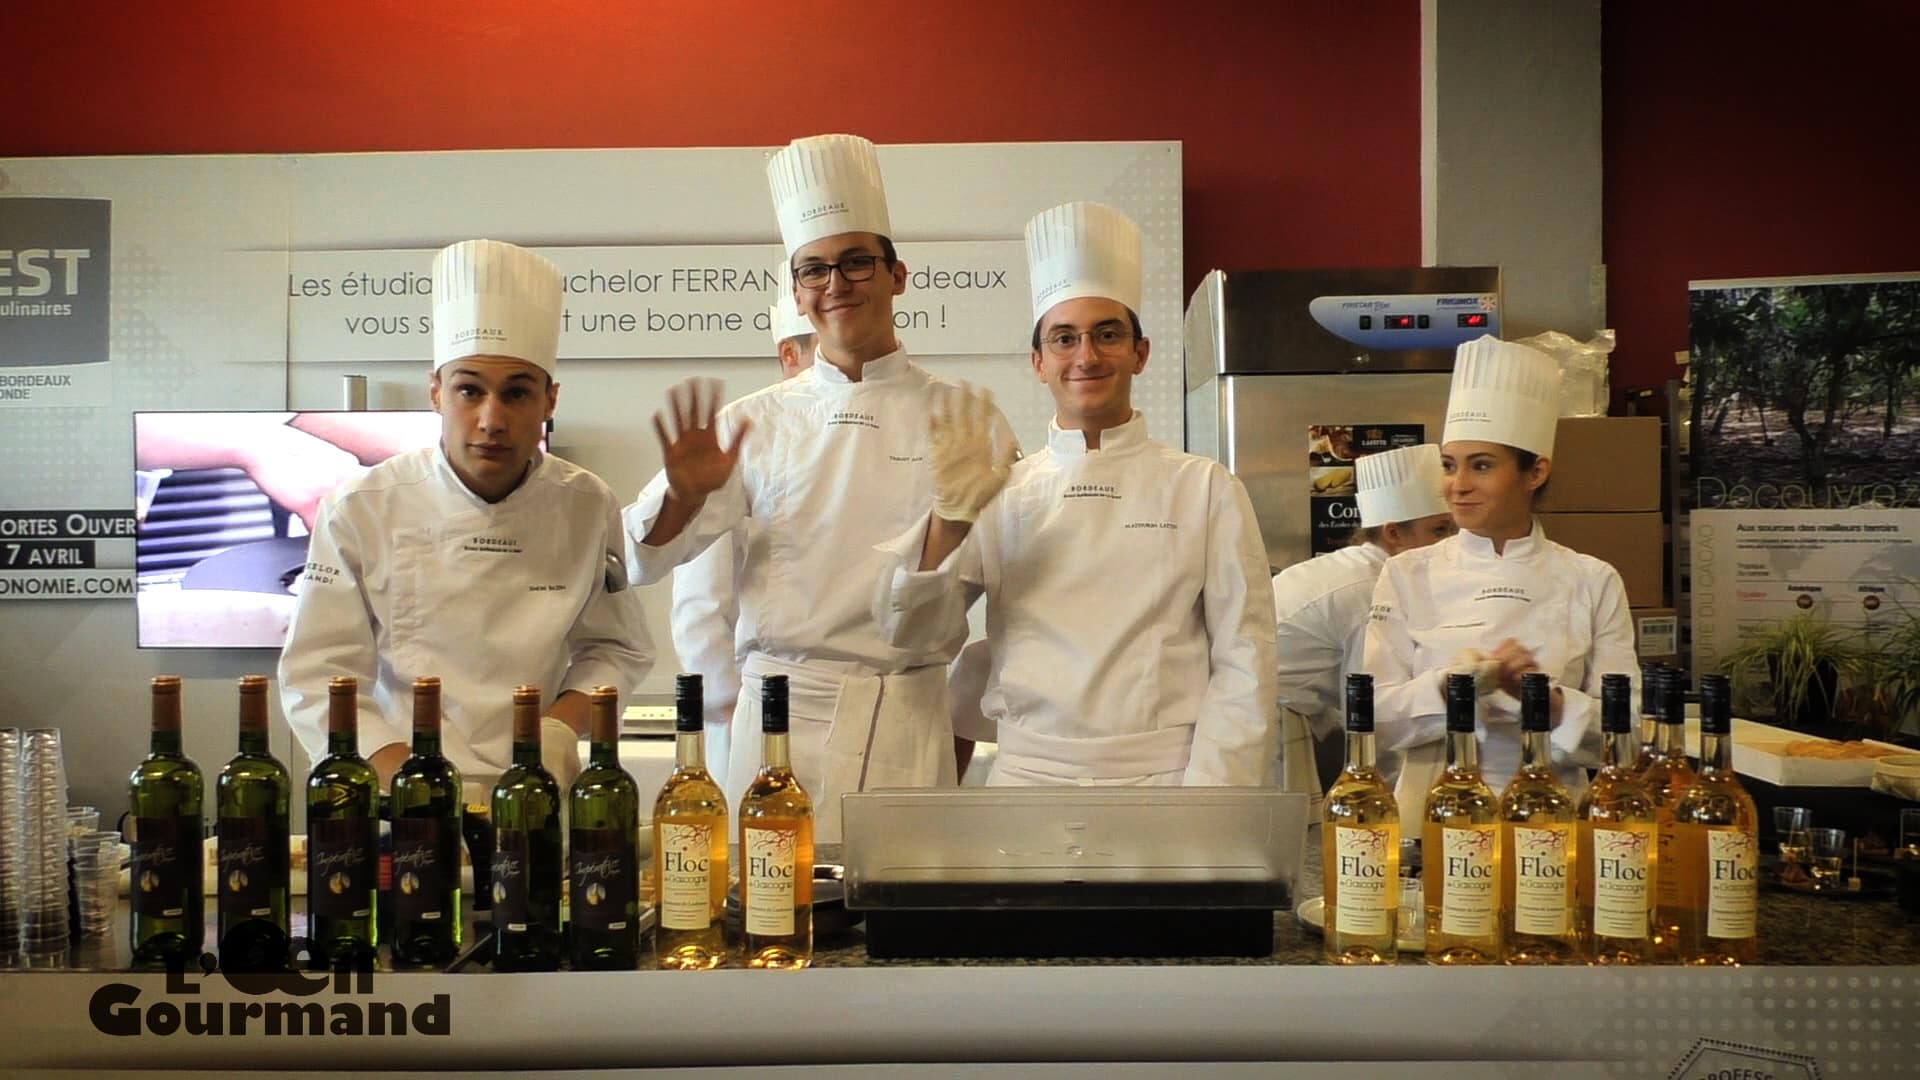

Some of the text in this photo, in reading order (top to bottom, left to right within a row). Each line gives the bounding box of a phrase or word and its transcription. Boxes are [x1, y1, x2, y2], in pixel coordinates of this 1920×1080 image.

[288, 274, 331, 297] Les
[341, 272, 432, 296] étudia
[562, 269, 663, 293] chelor
[672, 268, 779, 292] FERRAN
[1, 301, 72, 316] ulinaires
[345, 316, 410, 335] vous
[582, 313, 636, 332] une
[648, 308, 742, 331] bonne
[0, 375, 71, 387] BORDEAUX
[0, 389, 31, 400] ONDE
[1071, 485, 1115, 493] BORDEAUX
[1, 513, 136, 535] ORTES OUVER
[6, 544, 84, 565] 7 AVRIL
[0, 578, 134, 594] ONOMIE.COM
[665, 852, 708, 872] Floc
[751, 857, 793, 877] Floc
[1342, 856, 1385, 877] Floc
[1449, 857, 1492, 878] Floc
[1520, 857, 1566, 878] Floc
[1600, 859, 1646, 880] Floc
